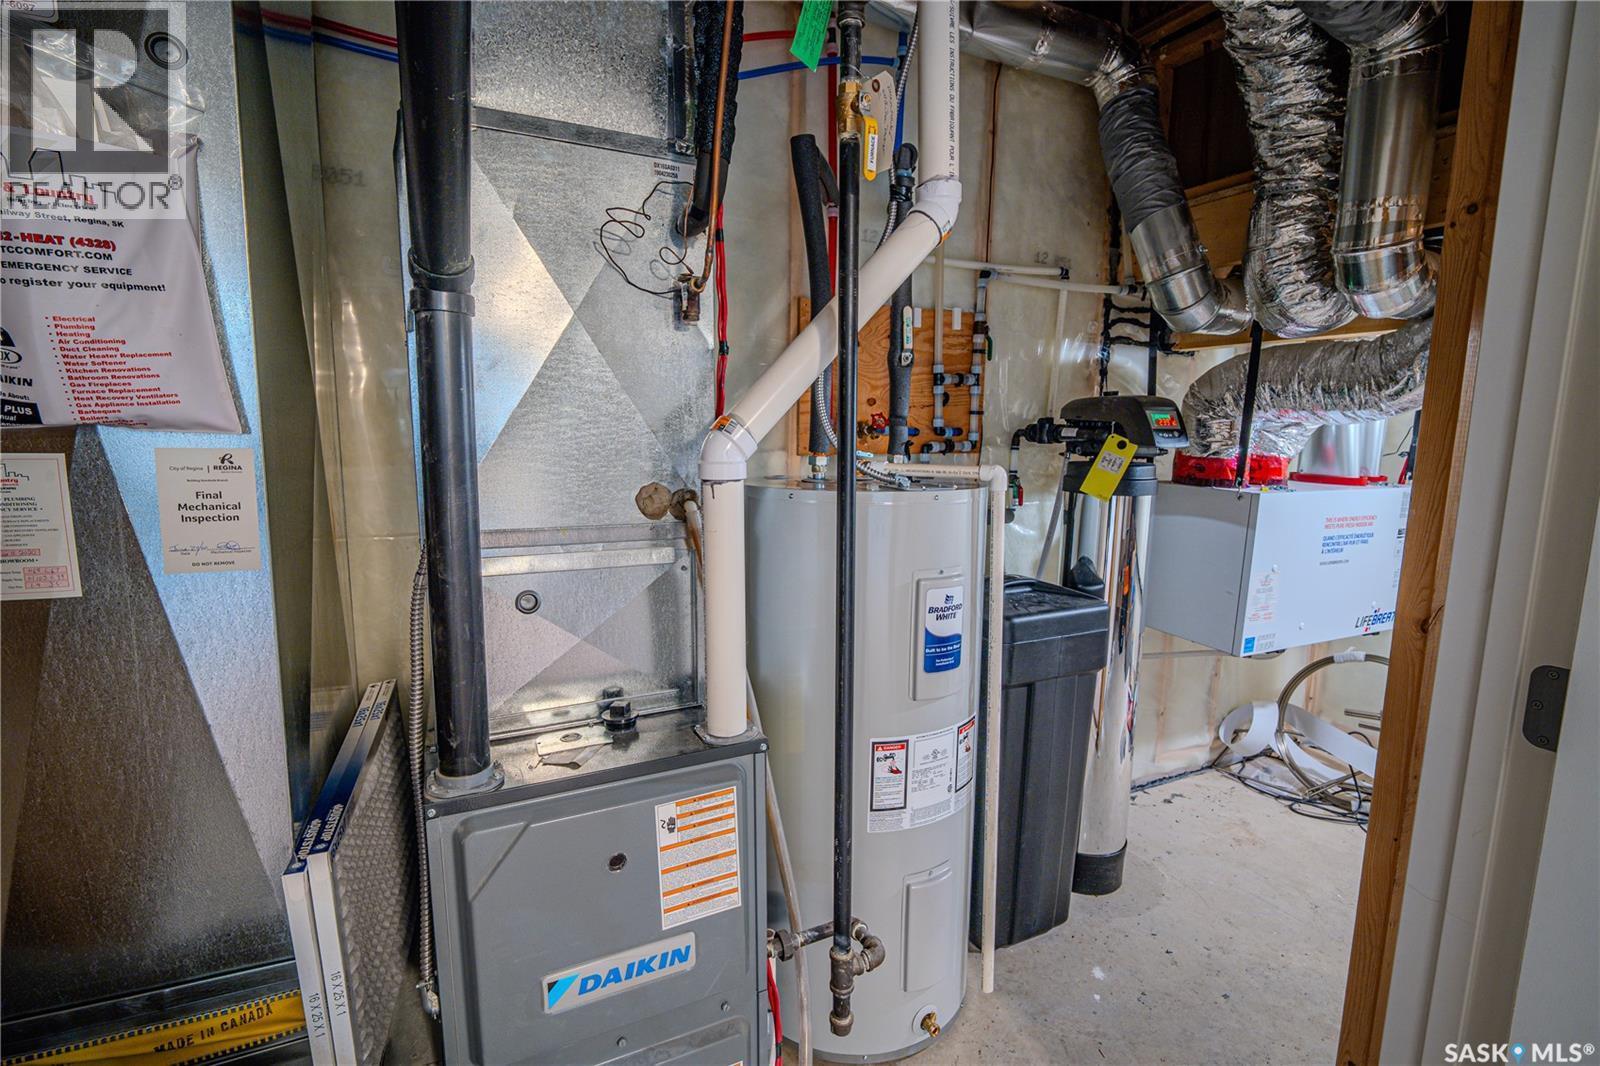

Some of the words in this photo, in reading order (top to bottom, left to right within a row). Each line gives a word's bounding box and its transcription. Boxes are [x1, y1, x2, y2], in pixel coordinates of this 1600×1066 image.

[34, 211, 71, 222] Street,
[70, 237, 116, 251] (4328)
[83, 266, 133, 276] SERVICE
[9, 278, 63, 289] register
[67, 281, 97, 290] your
[101, 284, 166, 293] equipment!
[54, 323, 96, 331] Plumbing
[108, 387, 161, 395] Replacement
[4, 405, 33, 415] PLUS
[195, 491, 222, 499] Final
[178, 502, 241, 511] Mechanical
[181, 514, 240, 525] Inspection
[928, 603, 963, 614] BRADFORD
[936, 612, 956, 621] WHITE
[578, 944, 691, 996] DAIKIN
[331, 971, 341, 981] 16
[309, 993, 320, 1003] 16
[334, 991, 344, 1001] 25
[312, 1012, 323, 1023] 25
[153, 1033, 195, 1053] MADE
[200, 1027, 215, 1040] IN
[220, 1003, 273, 1032] CANADA
